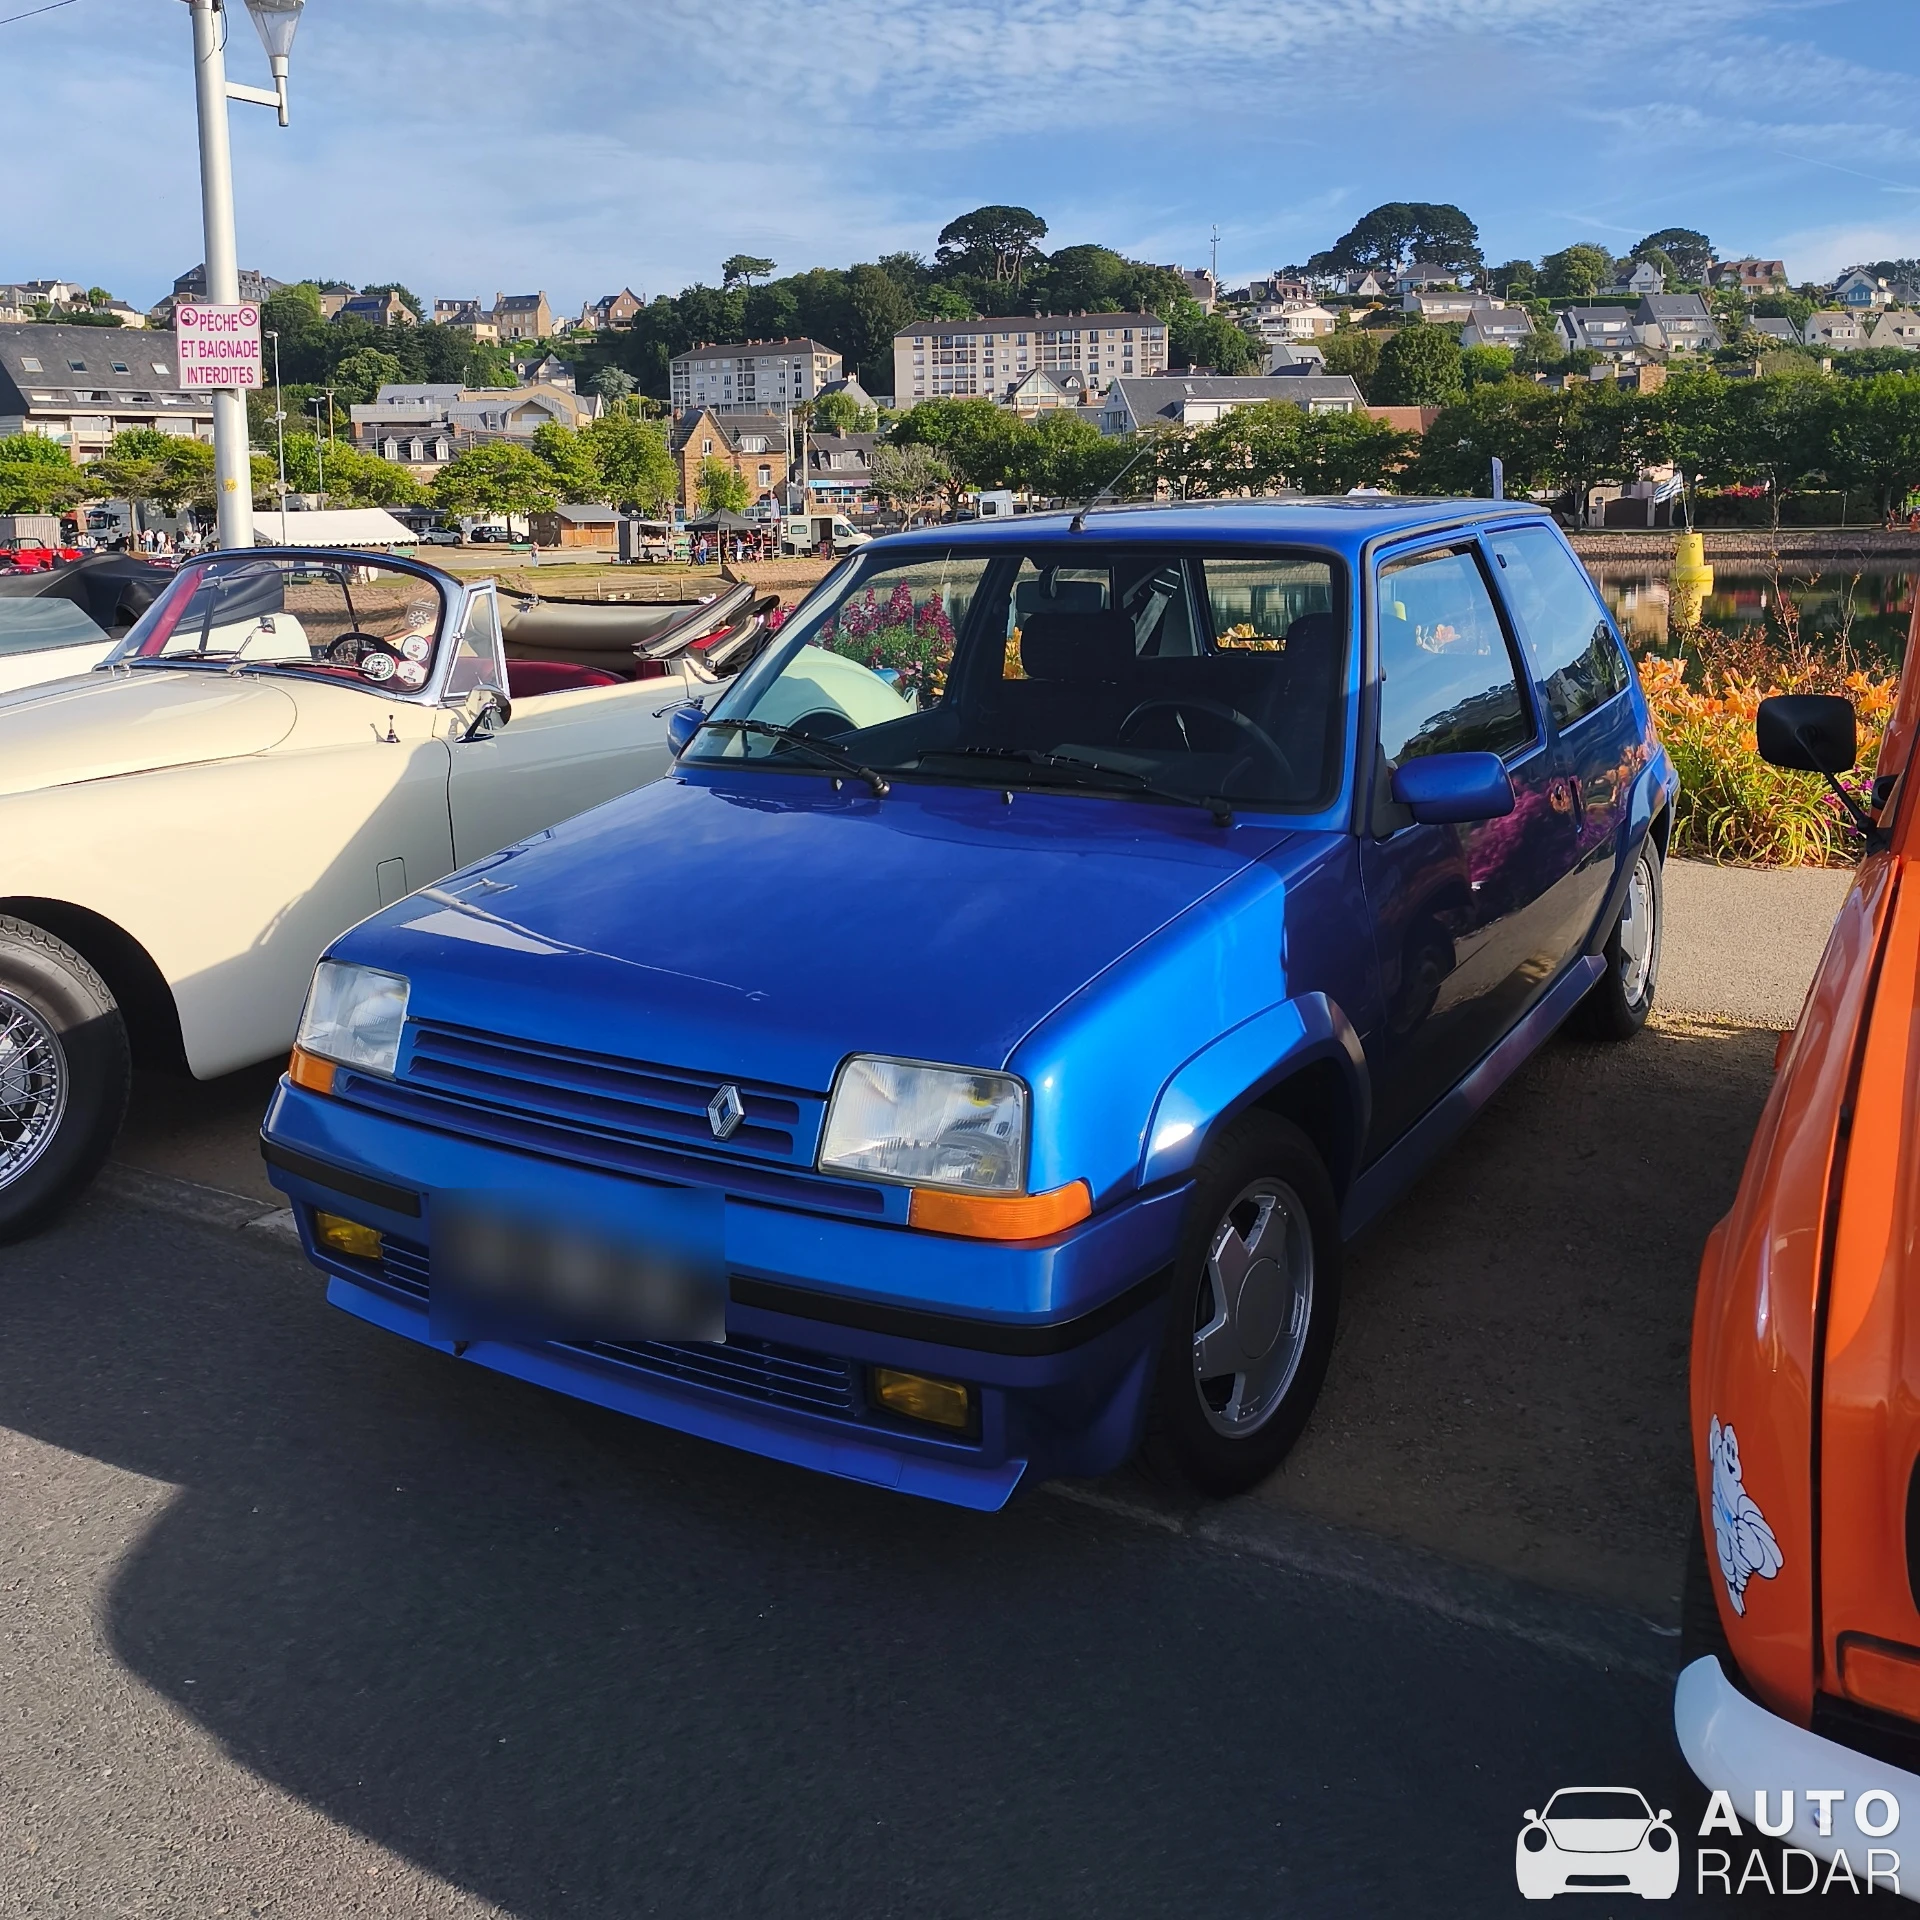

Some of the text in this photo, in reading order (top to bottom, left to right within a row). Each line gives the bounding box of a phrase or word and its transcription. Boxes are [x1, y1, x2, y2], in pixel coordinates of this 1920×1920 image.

[199, 310, 239, 332] PÊCHE
[181, 340, 259, 359] ET BAIGNADE
[187, 366, 254, 384] INTERDITES
